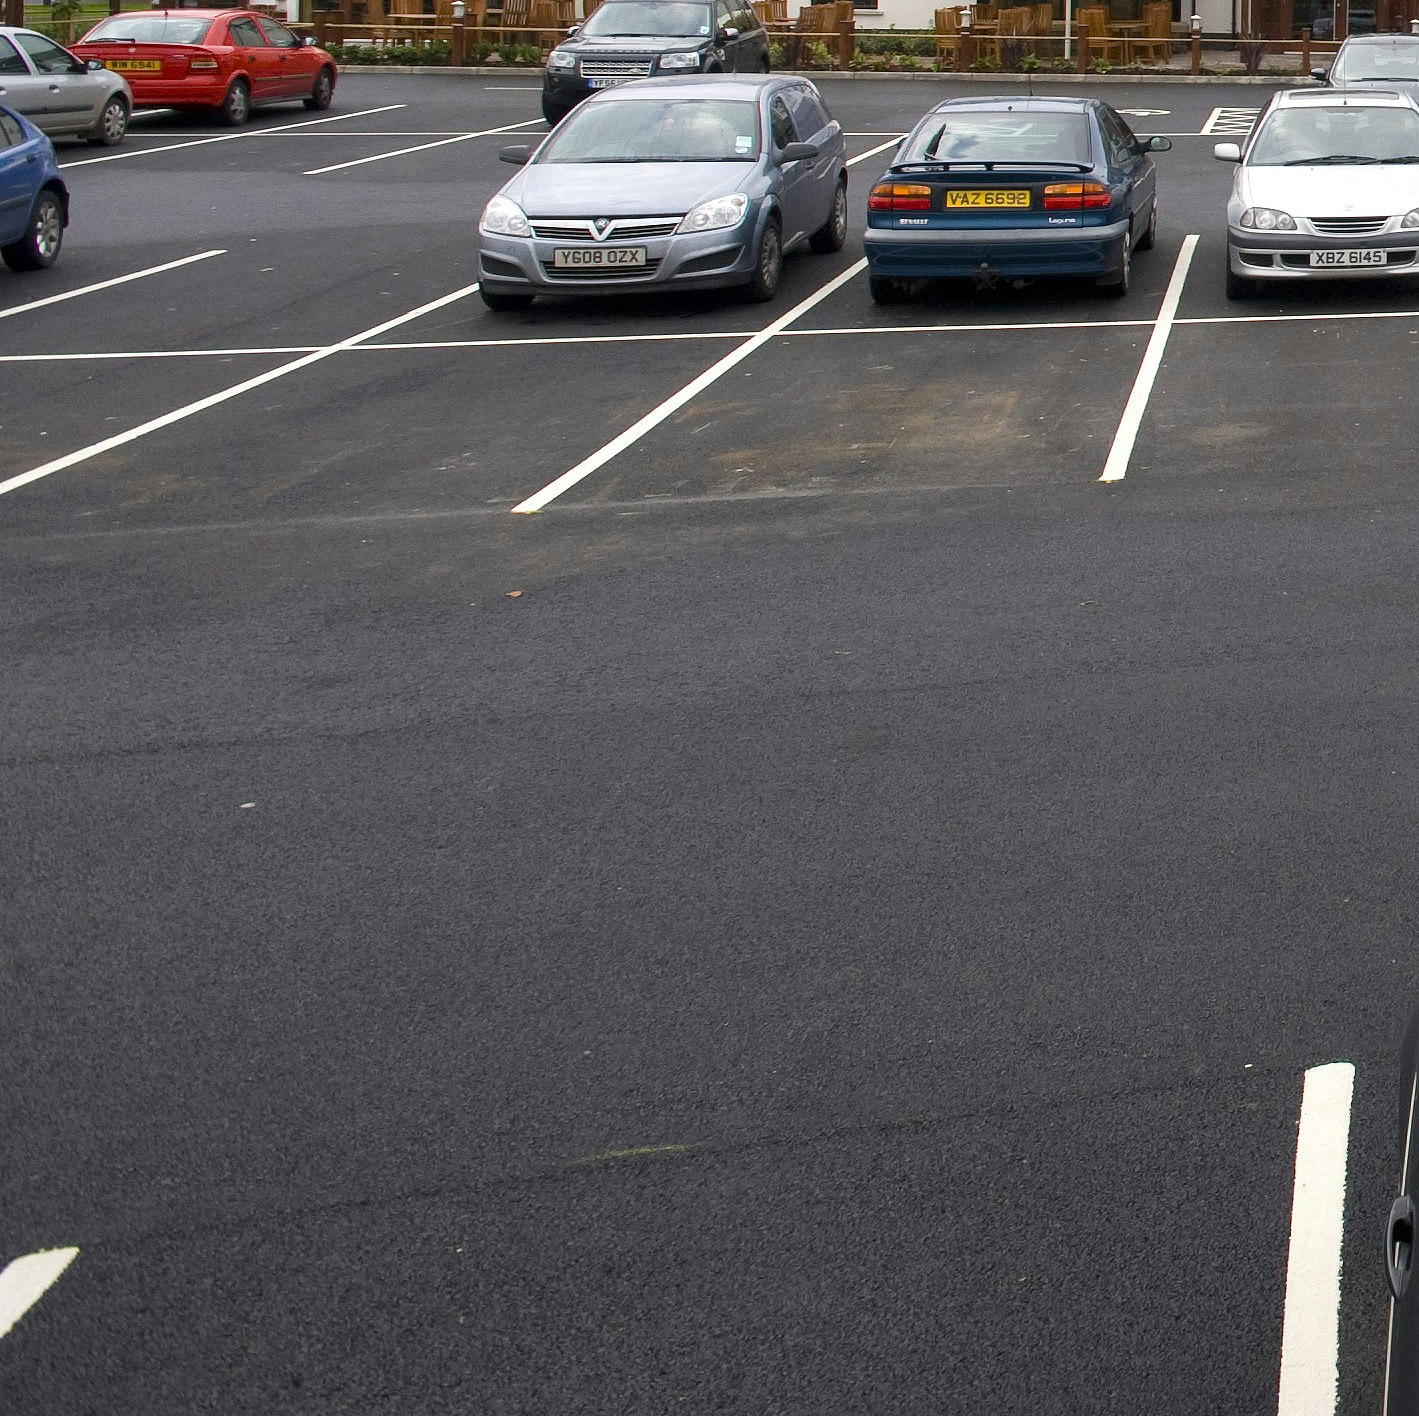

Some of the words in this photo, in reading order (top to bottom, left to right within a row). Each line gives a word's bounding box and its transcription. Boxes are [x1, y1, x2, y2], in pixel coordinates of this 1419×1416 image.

[949, 193, 981, 206] VAZ
[984, 192, 1028, 205] 6692
[561, 251, 603, 264] YG08
[607, 250, 639, 263] OZX
[1315, 252, 1345, 264] XBZ
[1349, 250, 1382, 264] 6145
